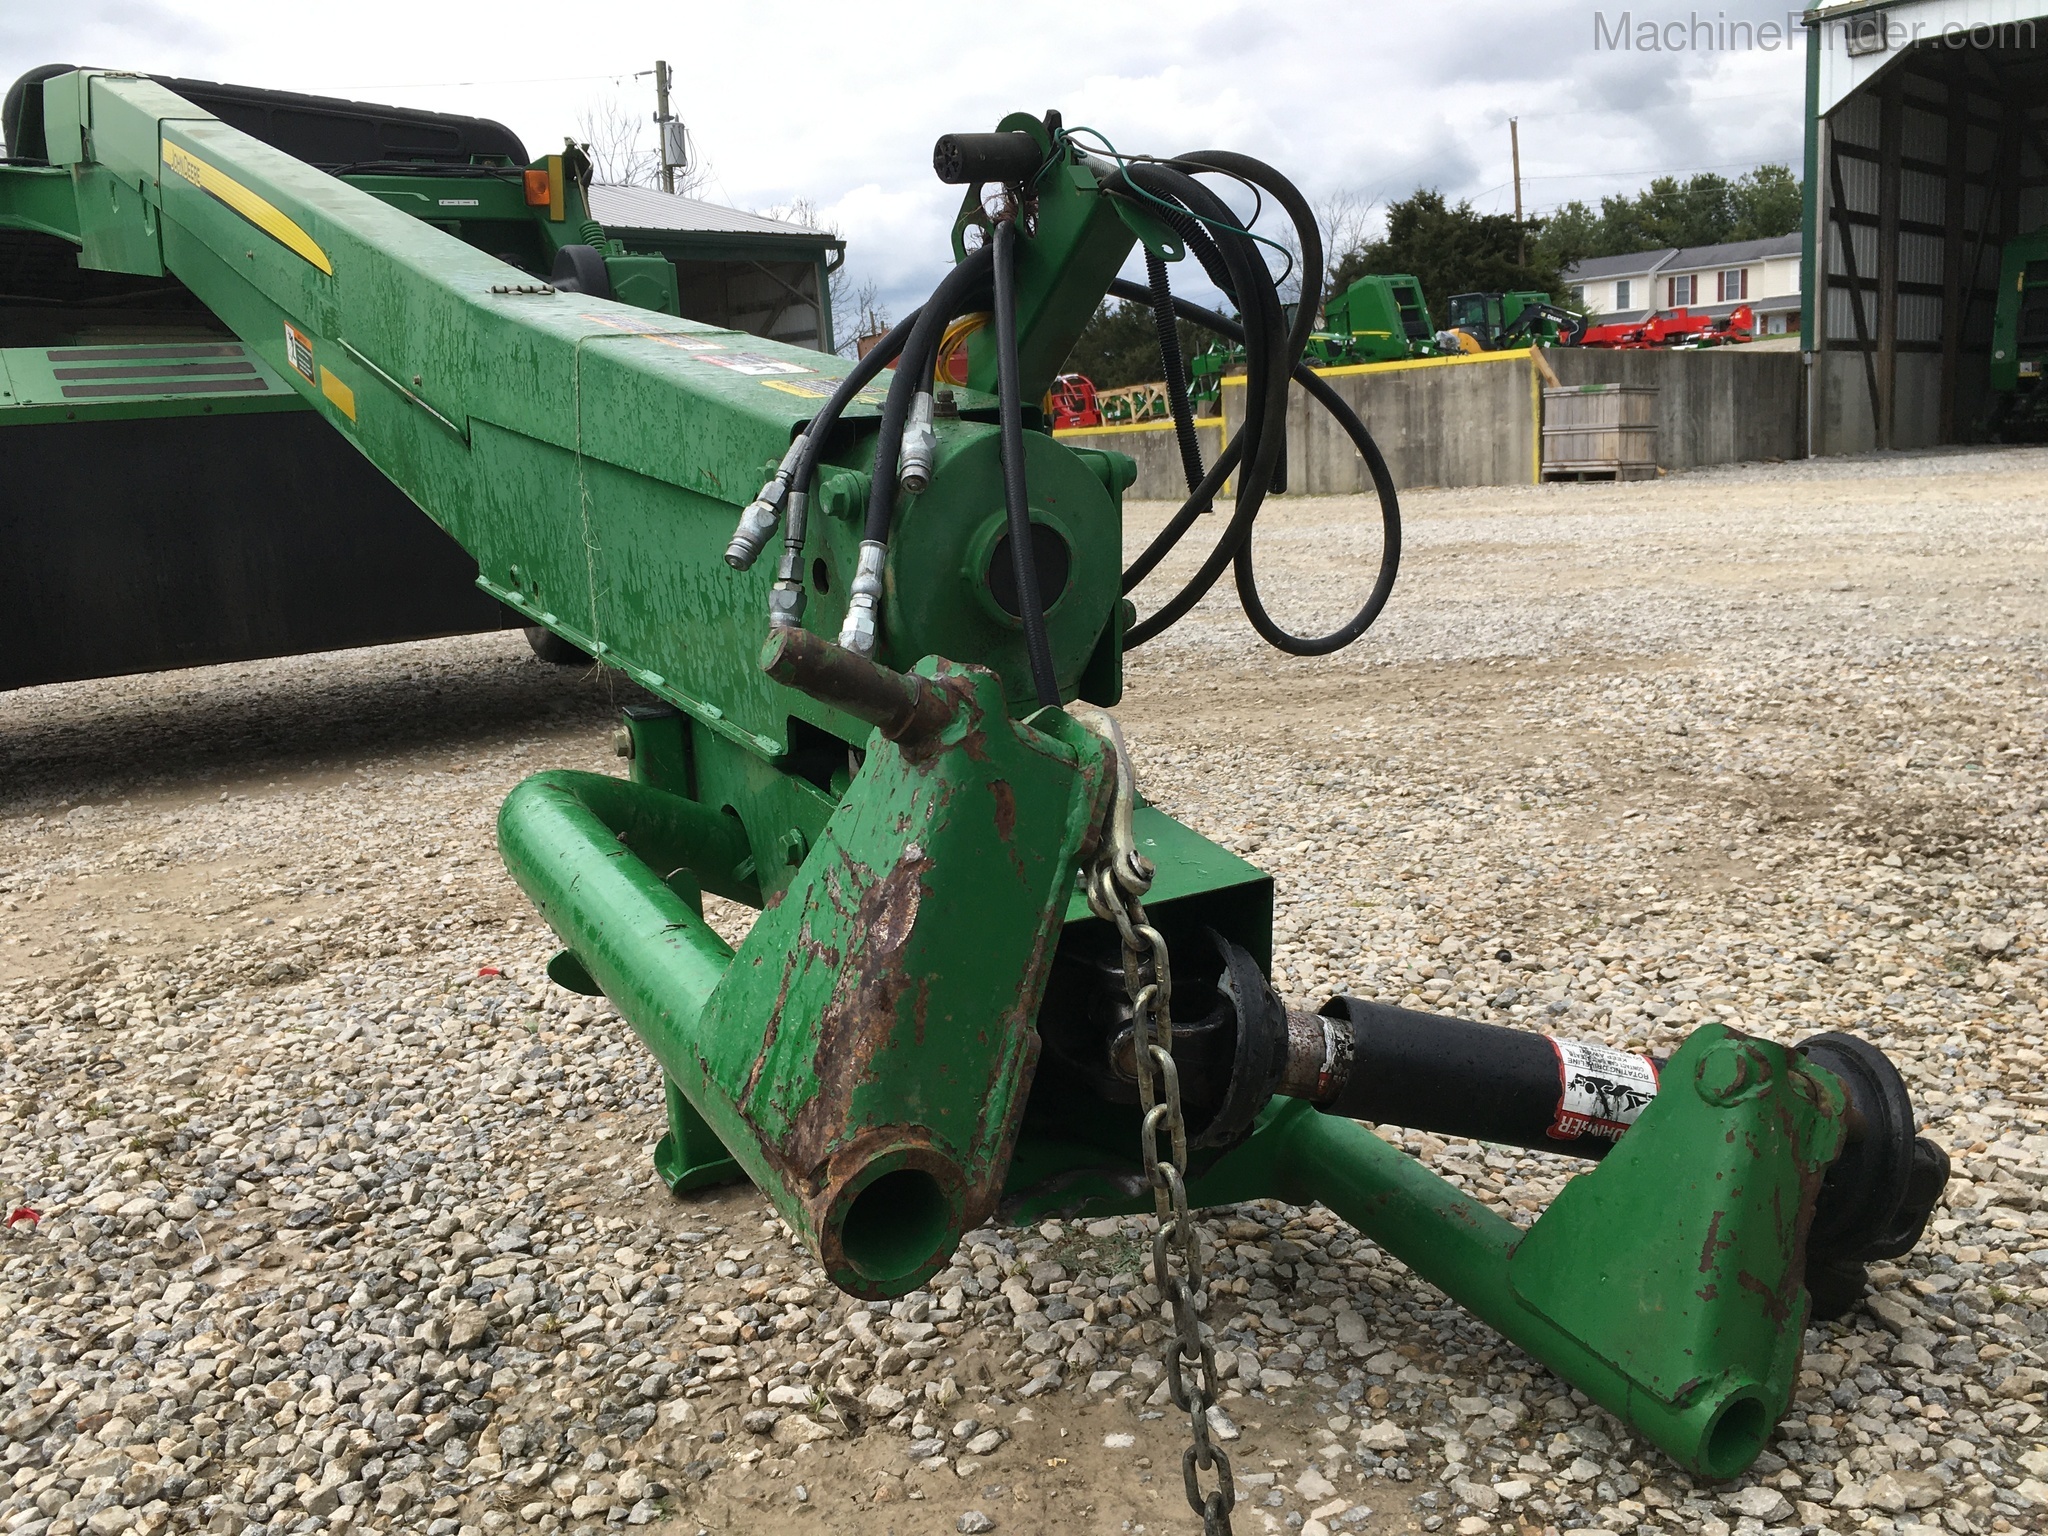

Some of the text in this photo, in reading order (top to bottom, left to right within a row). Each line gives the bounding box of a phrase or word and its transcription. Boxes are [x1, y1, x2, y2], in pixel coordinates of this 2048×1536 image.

[183, 155, 201, 187] DEERE
[1547, 313, 1562, 323] DEERE
[1610, 1066, 1649, 1080] ROTATING
